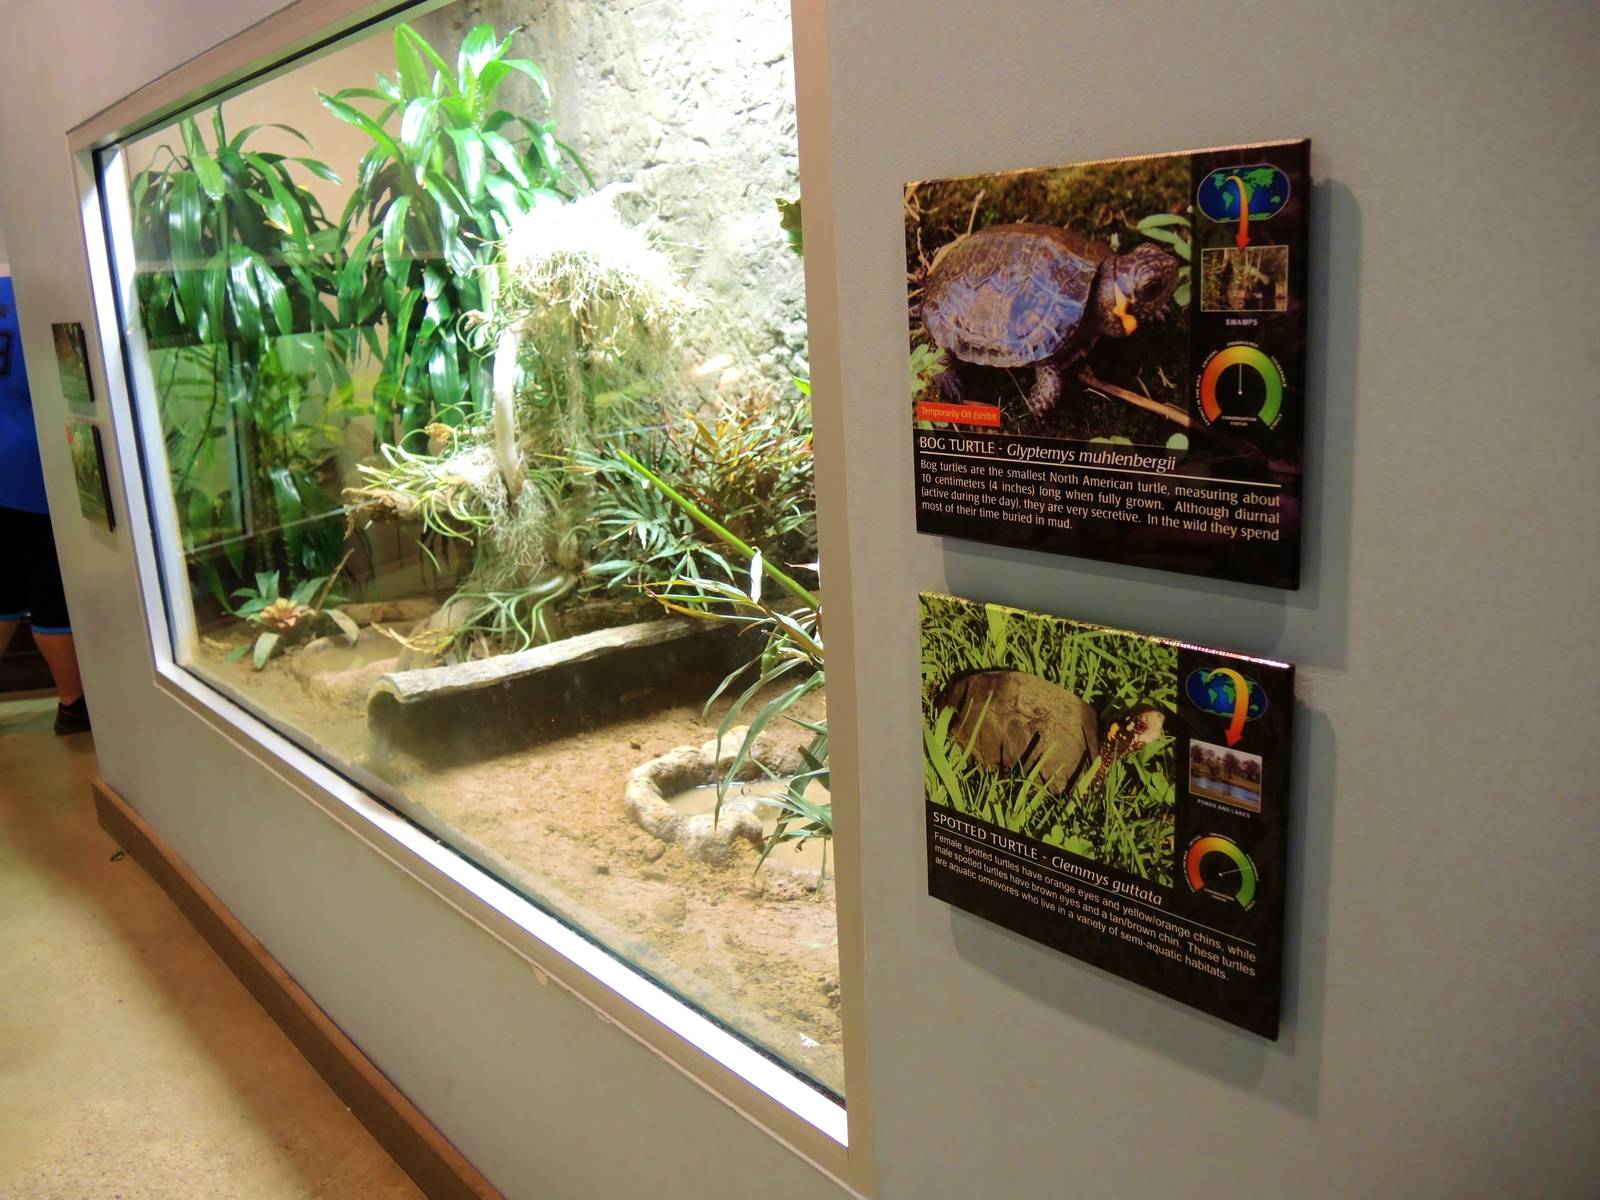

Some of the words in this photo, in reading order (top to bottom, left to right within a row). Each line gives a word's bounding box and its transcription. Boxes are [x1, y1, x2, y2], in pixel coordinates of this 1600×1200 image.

[922, 407, 959, 419] Temporarily
[973, 412, 996, 421] Exhibit
[920, 436, 945, 449] BOG
[949, 439, 995, 454] TURTLE
[1007, 444, 1075, 463] Glyptemys
[1079, 450, 1176, 473] muhlenbergii
[921, 460, 936, 472] Bog
[940, 462, 967, 473] turtles
[971, 465, 985, 475] are
[989, 466, 1003, 477] the
[1007, 468, 1046, 482] smallest
[1050, 472, 1078, 485] North
[1083, 476, 1133, 490] American
[1138, 481, 1170, 496] turtle,
[1175, 486, 1238, 505] measuring
[1243, 493, 1280, 507] about
[922, 473, 931, 483] 10
[935, 476, 985, 489] centimeters
[989, 481, 997, 491] (4
[1002, 482, 1035, 496] inches)
[1039, 486, 1061, 500] long
[1066, 489, 1093, 501] when
[1099, 492, 1121, 507] fully
[1126, 497, 1164, 510] grown.
[1175, 502, 1229, 520] Although
[1235, 509, 1280, 524] diurnal
[922, 486, 949, 499] (active
[951, 490, 979, 505] during
[982, 494, 996, 505] the
[1024, 499, 1045, 513] they
[1047, 503, 1063, 514] are
[1067, 506, 1088, 519] very
[1091, 507, 1141, 524] secretive.
[1148, 514, 1158, 525] In
[1162, 516, 1179, 528] the
[1183, 519, 1207, 532] wild
[1211, 522, 1237, 538] they
[1241, 526, 1279, 541] spend
[922, 501, 942, 512] most
[945, 503, 954, 513] of
[957, 506, 976, 516] their
[979, 508, 999, 519] time
[1003, 510, 1032, 524] buried
[1036, 513, 1044, 525] in
[1048, 516, 1072, 529] mud.
[1197, 799, 1216, 808] PONDS
[1218, 805, 1230, 813] AND
[1231, 808, 1251, 819] LAKES
[933, 812, 986, 840] SPOTTED
[991, 832, 1038, 860] TURTLE
[1052, 856, 1109, 885] Clemmys
[1113, 880, 1162, 905] guttata
[935, 832, 962, 850] Female
[964, 844, 992, 862] spotted
[995, 856, 1019, 873] turtles
[1022, 865, 1042, 881] have
[1045, 876, 1075, 894] orange
[1078, 889, 1100, 903] eyes
[1102, 897, 1119, 911] and
[1123, 905, 1190, 937] yellow/orange
[1194, 931, 1224, 950] chins,
[1228, 945, 1256, 962] while
[935, 845, 952, 857] male
[955, 852, 982, 870] spotted
[984, 863, 1008, 880] turtles
[1009, 873, 1030, 889] have
[1032, 881, 1057, 900] brown
[1059, 894, 1080, 908] eyes
[1082, 902, 1100, 916] and
[1102, 911, 1107, 919] a
[1110, 913, 1156, 939] tan/brown
[1159, 929, 1181, 949] chin.
[1188, 941, 1219, 962] These
[1222, 956, 1255, 977] turtles
[935, 857, 947, 867] are
[949, 863, 977, 879] aquatic
[978, 875, 1019, 897] omnivores
[1022, 892, 1038, 905] who
[1041, 898, 1055, 912] live
[1058, 906, 1066, 915] in
[1068, 910, 1074, 919] a
[1076, 914, 1106, 934] variety
[1109, 927, 1118, 936] of
[1121, 930, 1183, 962] semi-aquatic
[1185, 954, 1229, 981] habitats.
